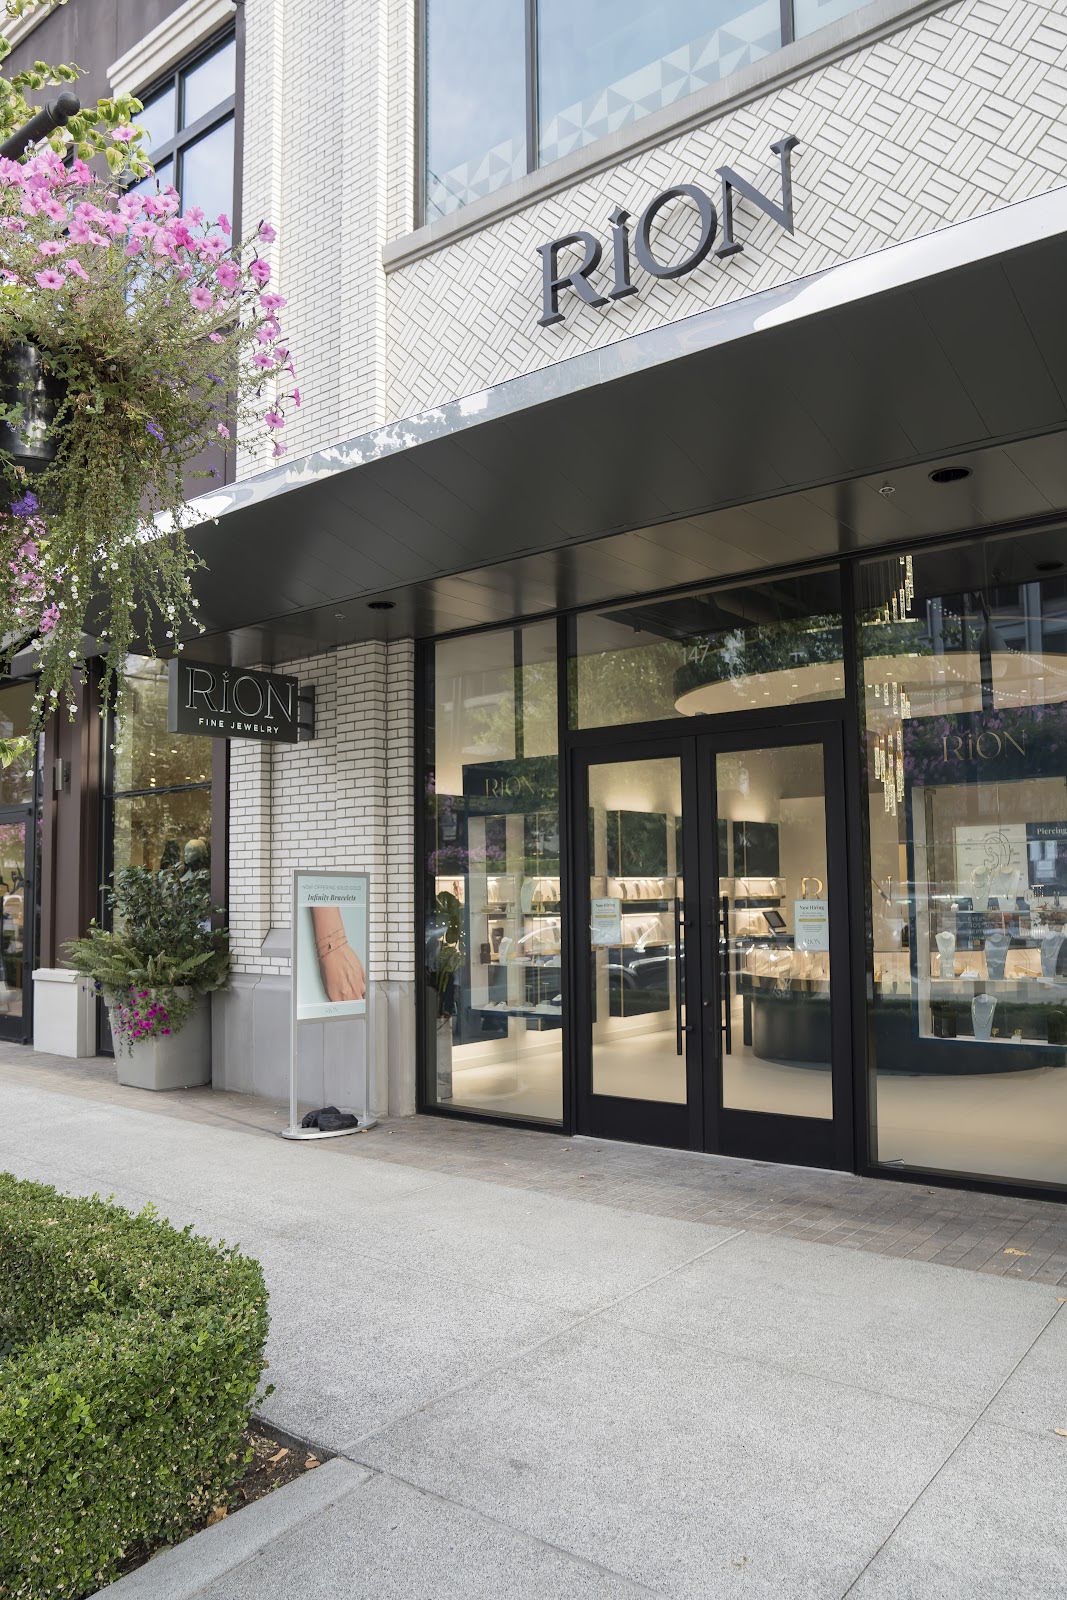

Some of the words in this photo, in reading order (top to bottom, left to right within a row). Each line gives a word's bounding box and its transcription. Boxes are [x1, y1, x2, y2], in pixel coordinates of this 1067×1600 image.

[536, 135, 800, 327] RiON
[681, 644, 709, 665] 147
[185, 667, 295, 722] RiON
[198, 717, 225, 729] FINE
[230, 721, 279, 734] JEWELRY
[307, 893, 329, 902] Infinity
